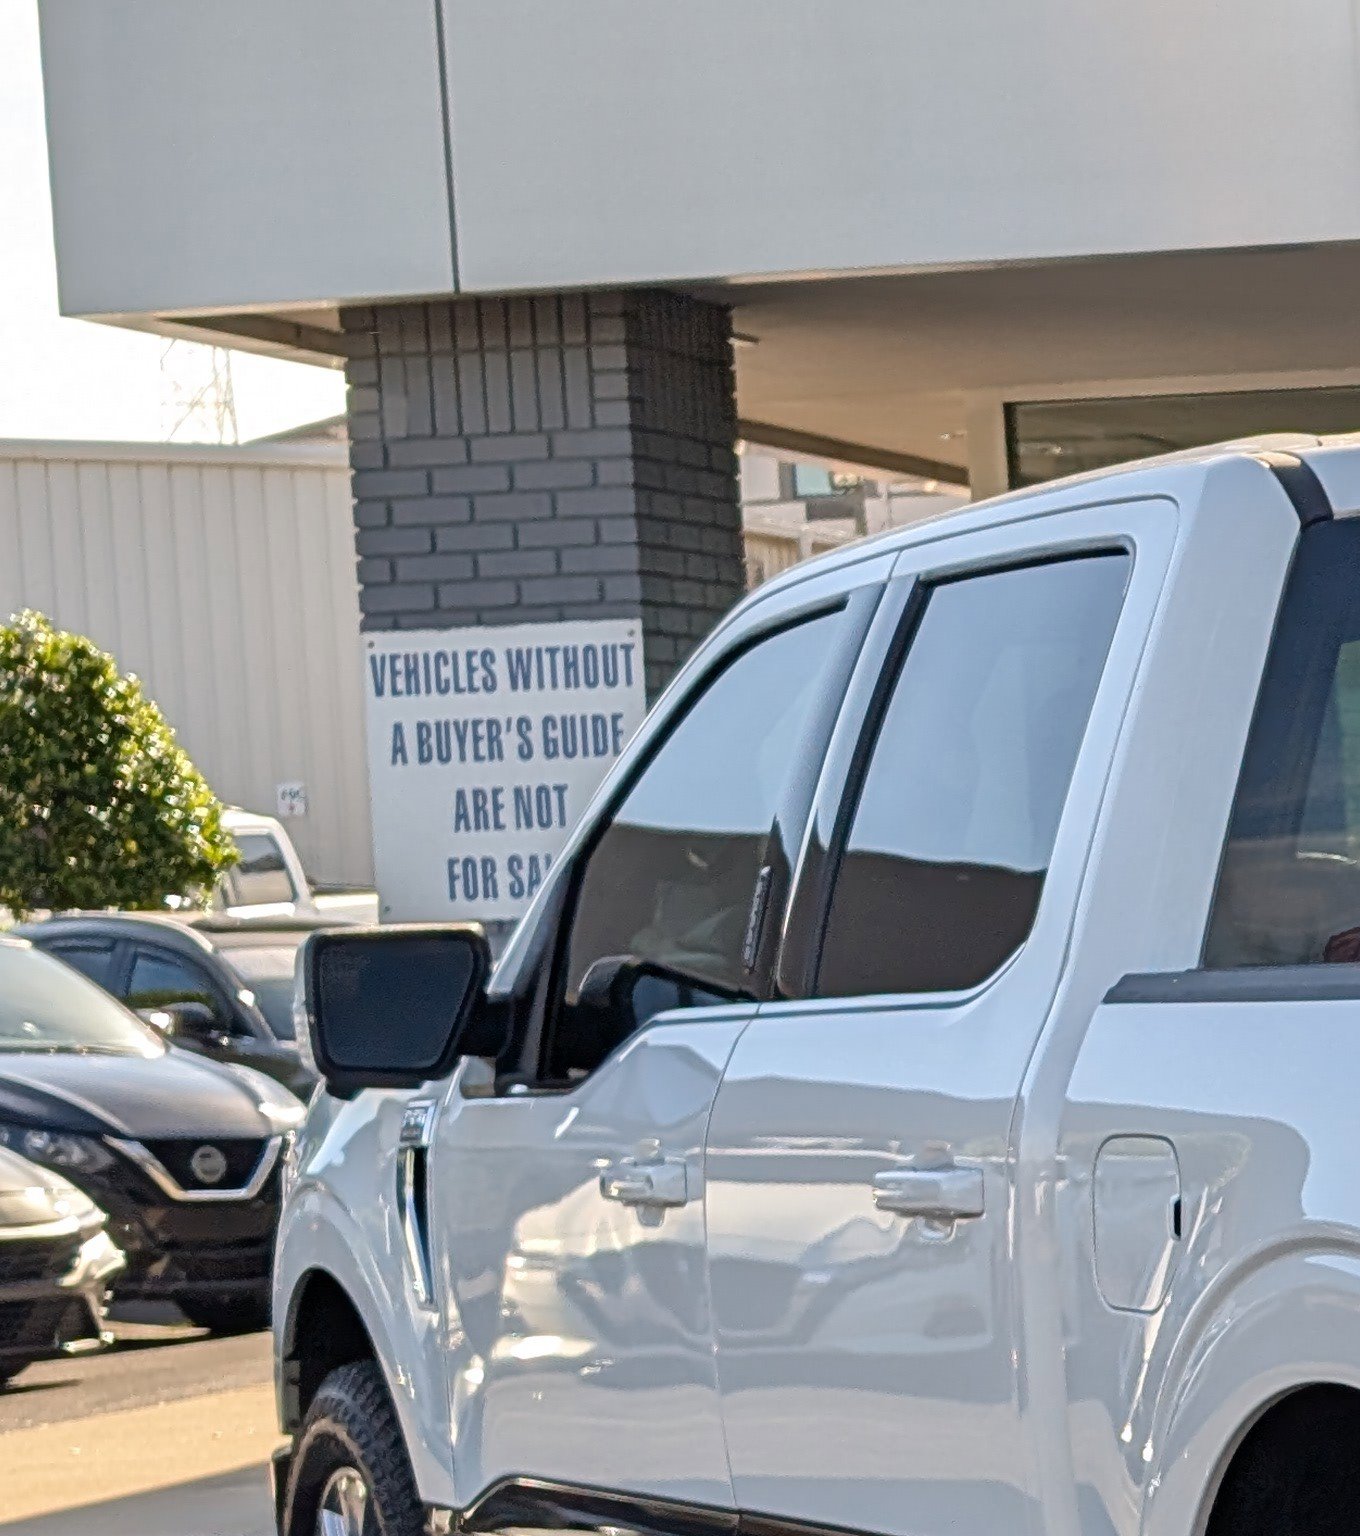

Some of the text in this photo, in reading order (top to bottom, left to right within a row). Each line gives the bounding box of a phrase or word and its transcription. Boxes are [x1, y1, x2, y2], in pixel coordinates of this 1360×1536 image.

[370, 642, 635, 697] VEHICLES WITHOUT
[391, 711, 625, 766] A BUYER'S GUIDE
[454, 783, 568, 833] ARE NOT
[448, 855, 500, 903] FOR
